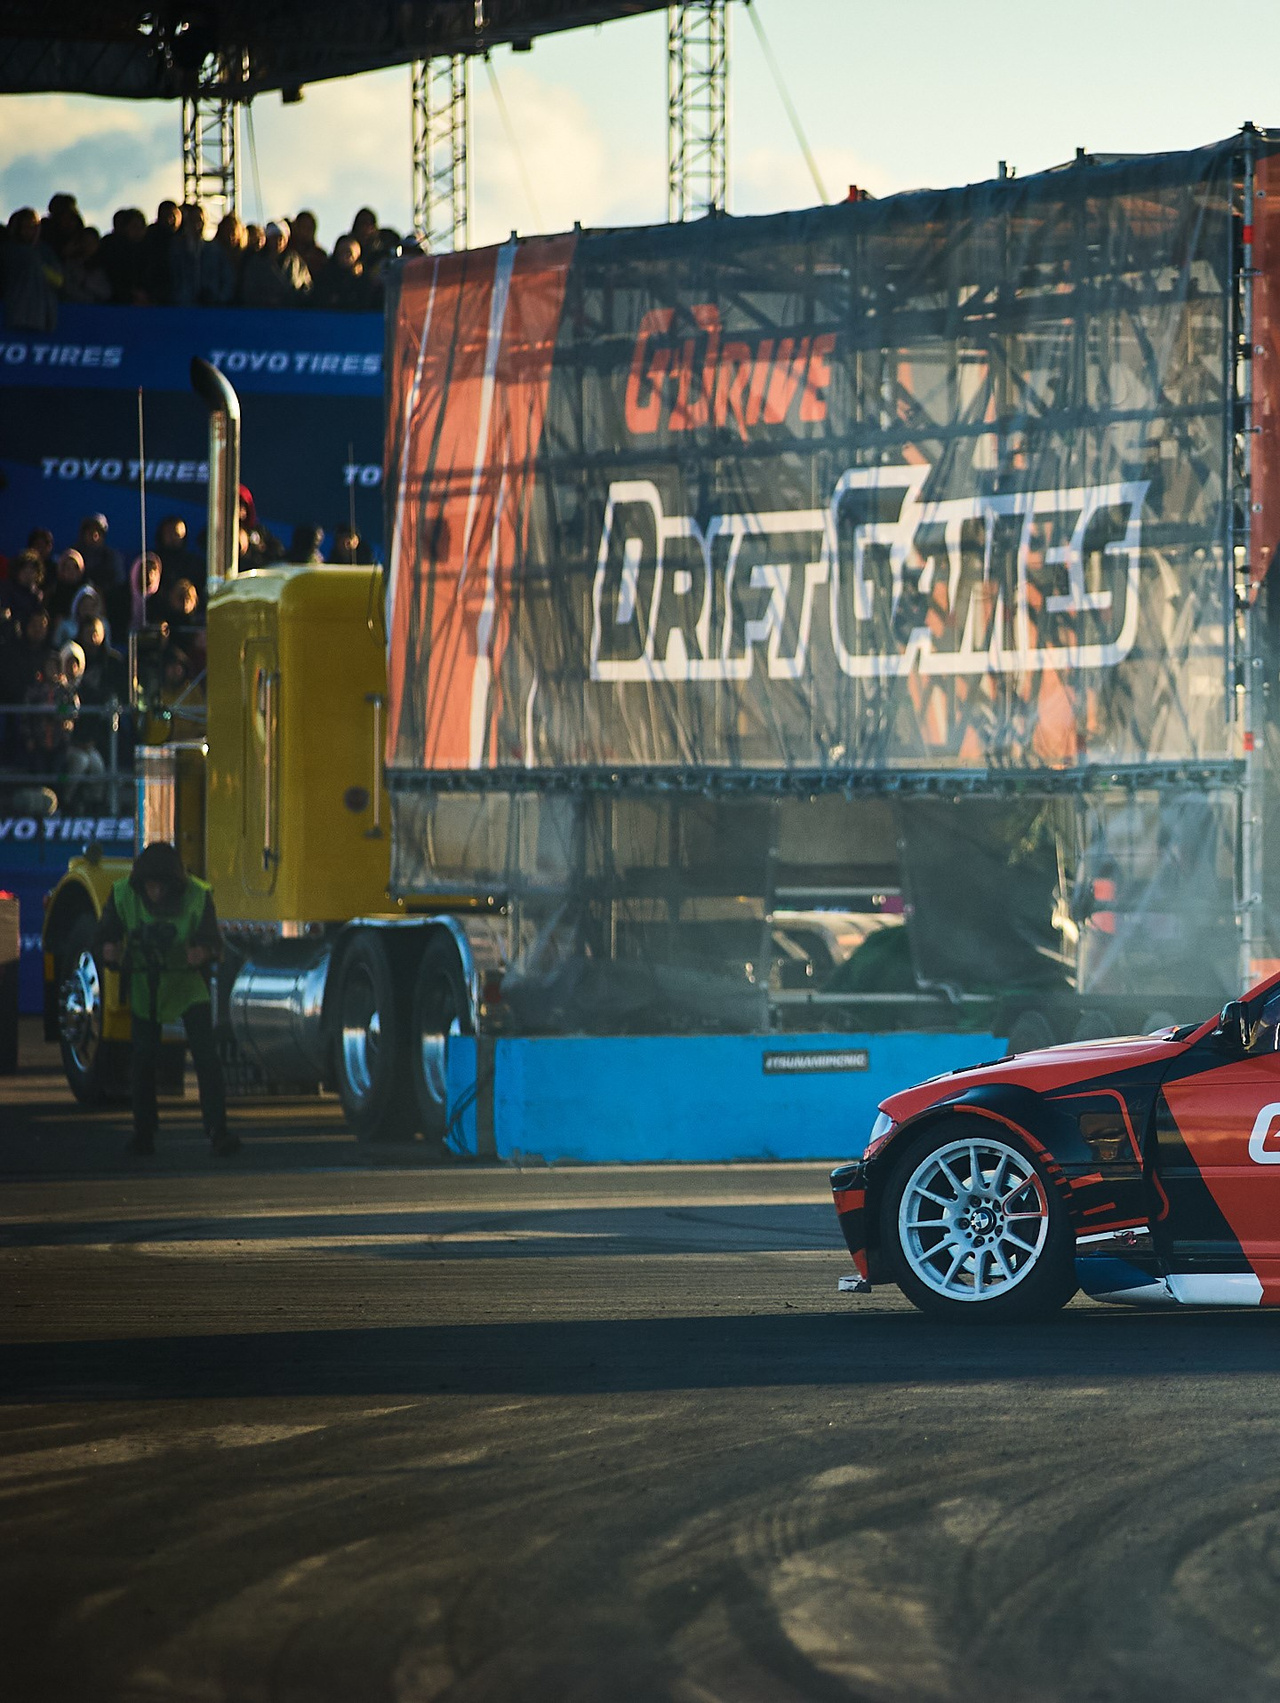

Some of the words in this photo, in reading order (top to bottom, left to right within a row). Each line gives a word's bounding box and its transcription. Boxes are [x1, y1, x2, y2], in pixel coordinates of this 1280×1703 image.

[31, 346, 123, 368] TIRES
[207, 350, 289, 372] TOYO
[295, 351, 382, 375] TIRES
[41, 457, 121, 480] TOYO
[590, 479, 832, 681] DRIFT
[43, 817, 134, 841] TIRES
